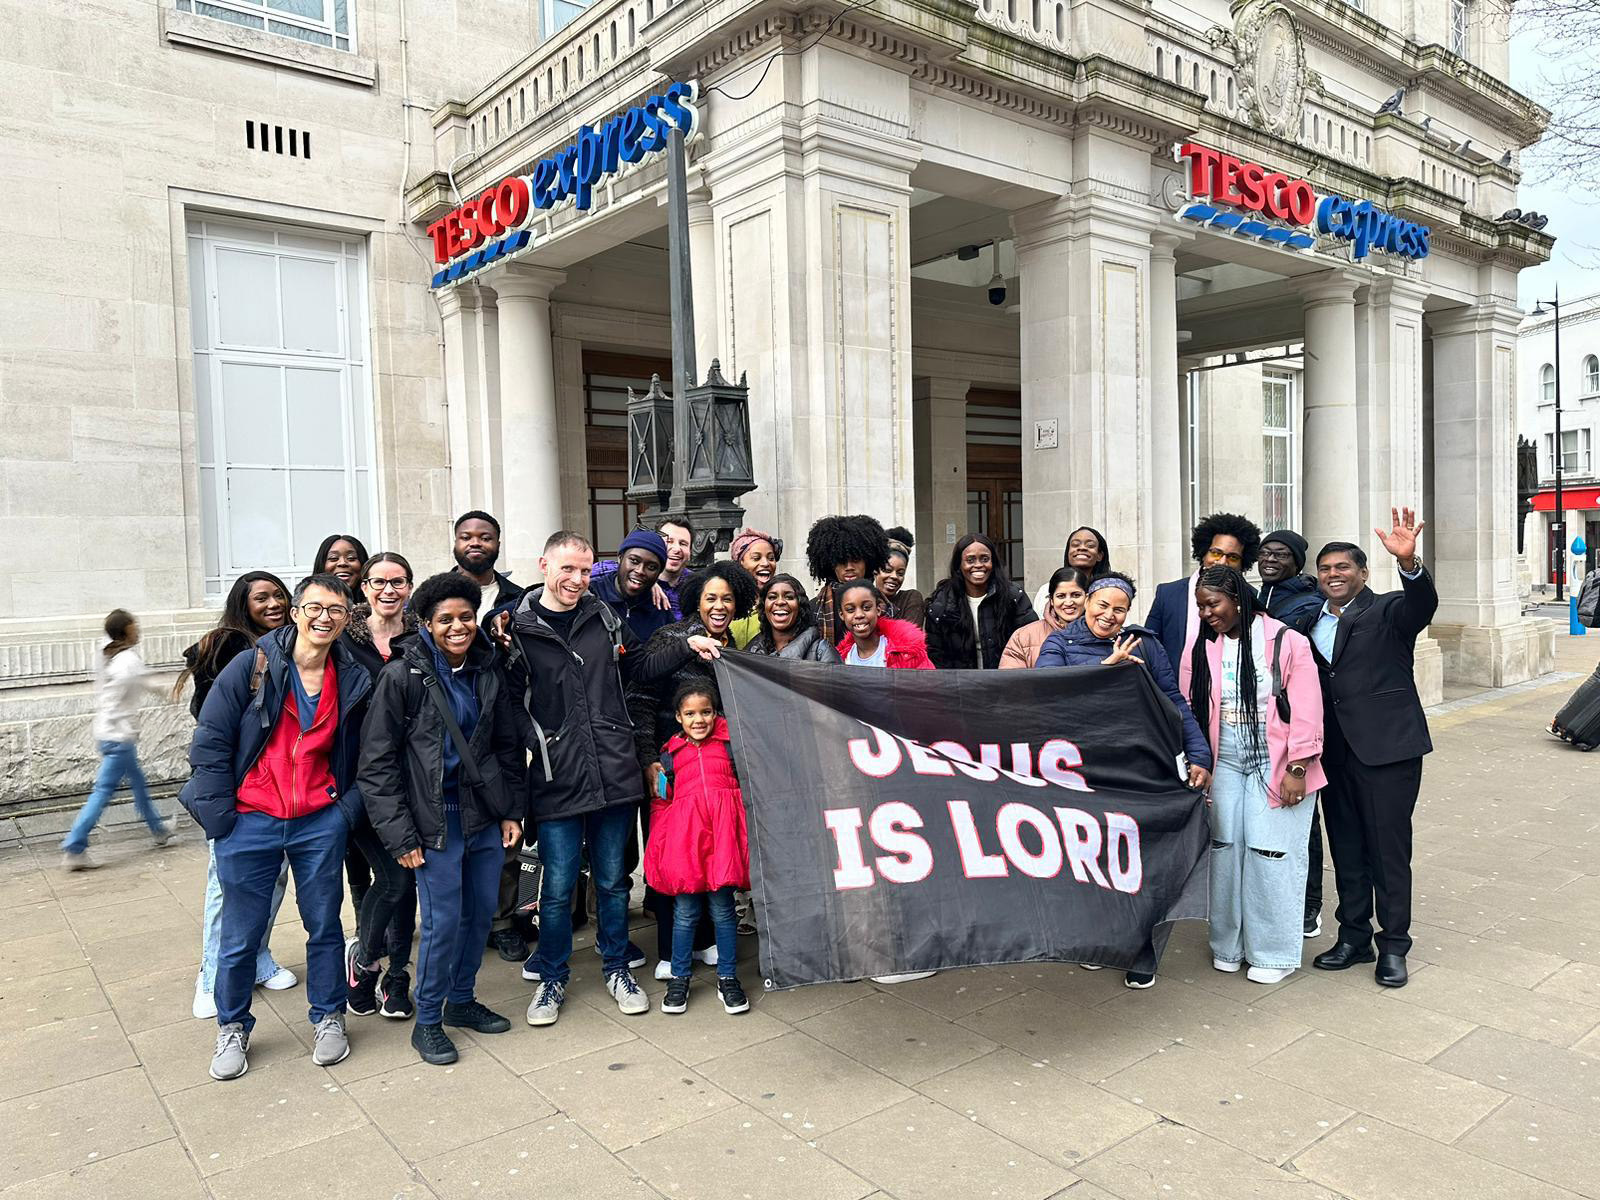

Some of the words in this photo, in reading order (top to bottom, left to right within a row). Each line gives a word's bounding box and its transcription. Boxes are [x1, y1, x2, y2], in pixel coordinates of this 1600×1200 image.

[426, 176, 529, 264] TESCO
[532, 81, 695, 210] express
[1181, 143, 1316, 226] TESCO
[1317, 195, 1430, 259] express
[824, 801, 934, 890] IS
[947, 800, 1143, 895] LORD
